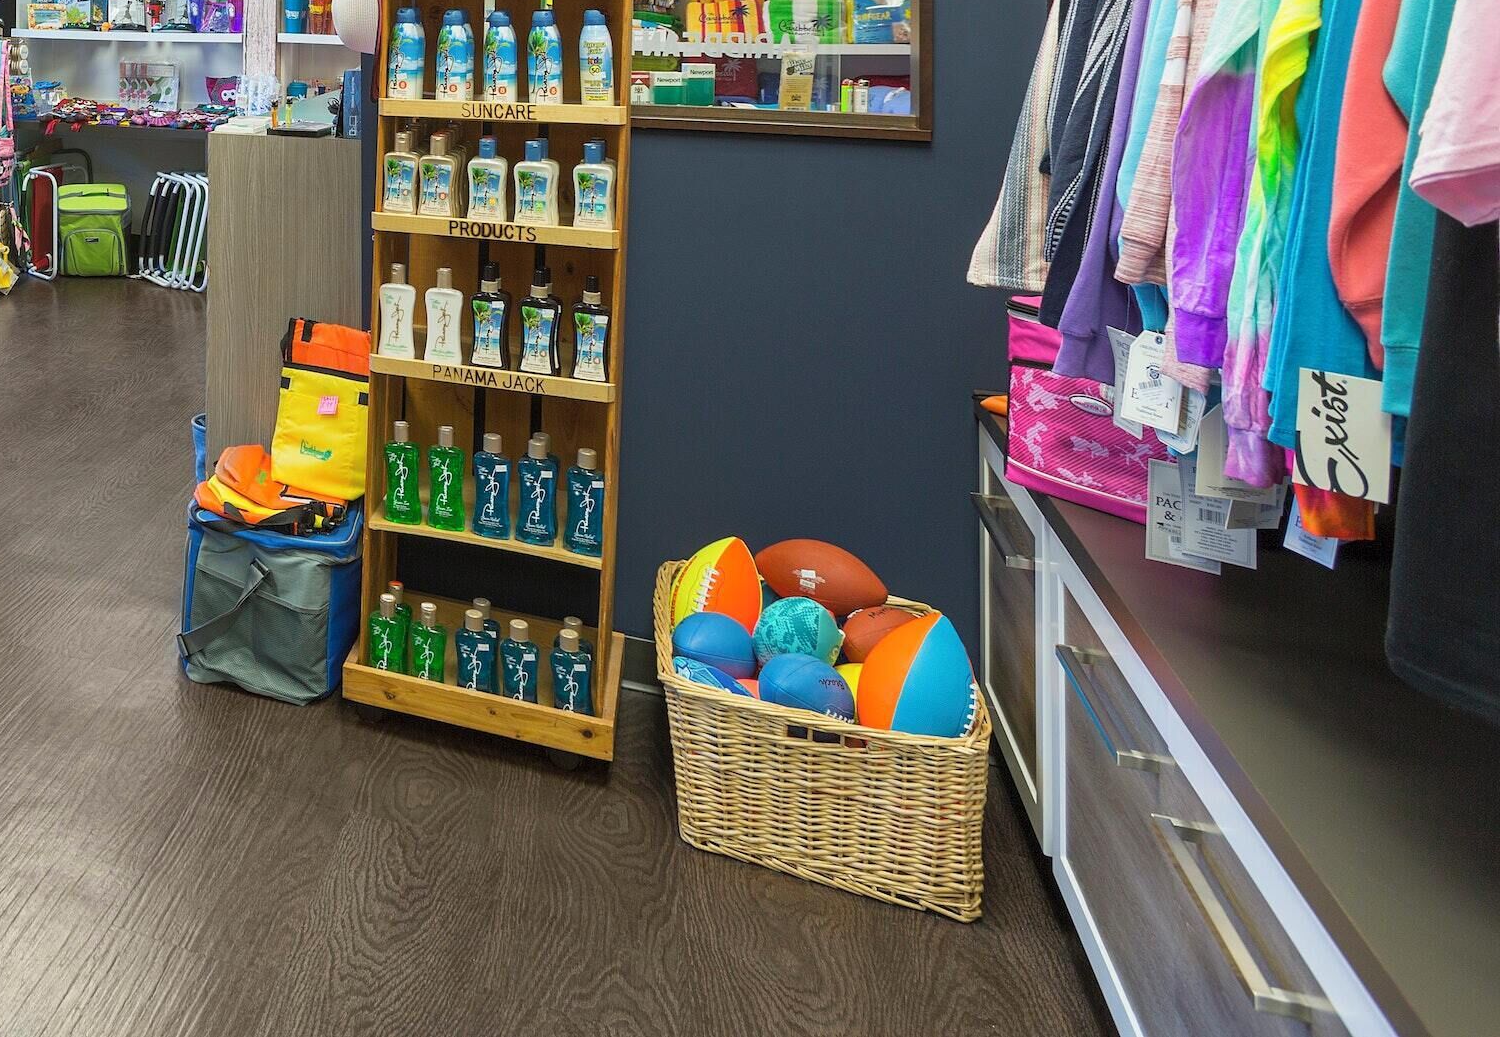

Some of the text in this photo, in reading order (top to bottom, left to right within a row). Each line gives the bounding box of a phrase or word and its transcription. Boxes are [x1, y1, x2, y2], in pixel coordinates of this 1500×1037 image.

[656, 76, 681, 84] Newport
[690, 68, 714, 76] Newport
[461, 103, 537, 121] SUNCARE
[449, 220, 537, 242] PRODUCTS
[433, 364, 546, 394] PANAMA JACK
[1295, 371, 1369, 499] Exist
